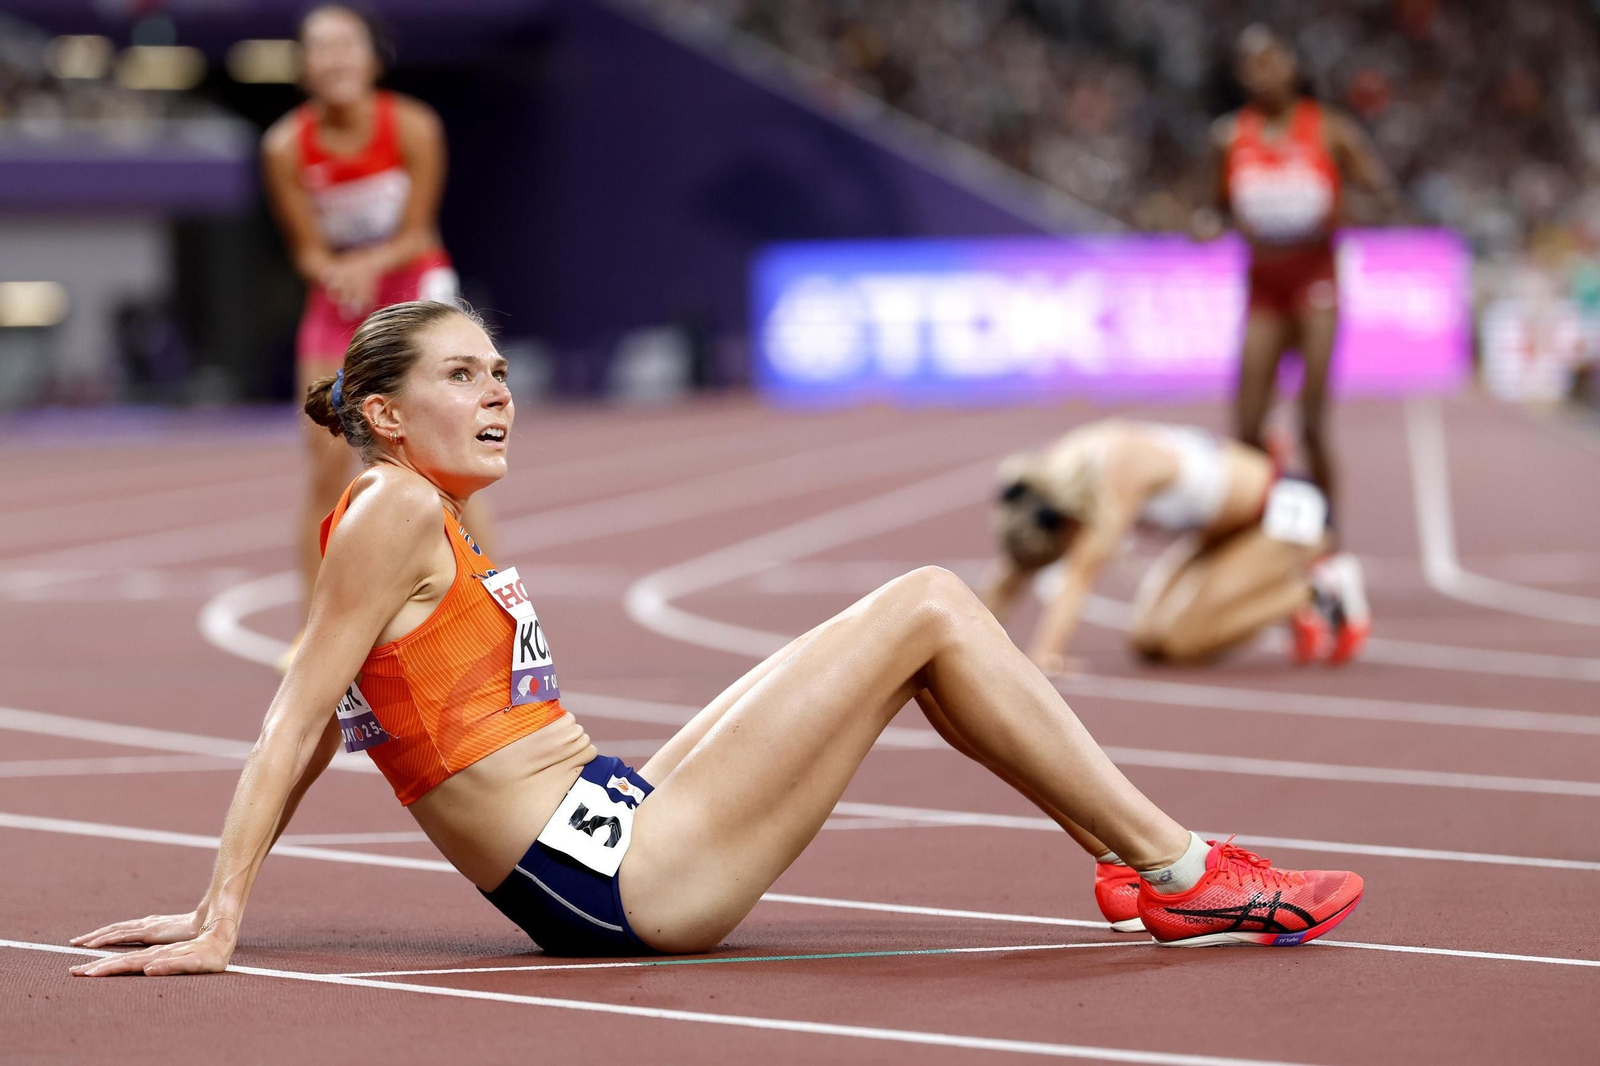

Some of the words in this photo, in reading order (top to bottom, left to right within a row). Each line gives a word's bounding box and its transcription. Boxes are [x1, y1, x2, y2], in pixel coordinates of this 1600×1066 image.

[520, 619, 551, 663] KO
[568, 802, 623, 849] 5
[1183, 915, 1215, 926] TOKYO
